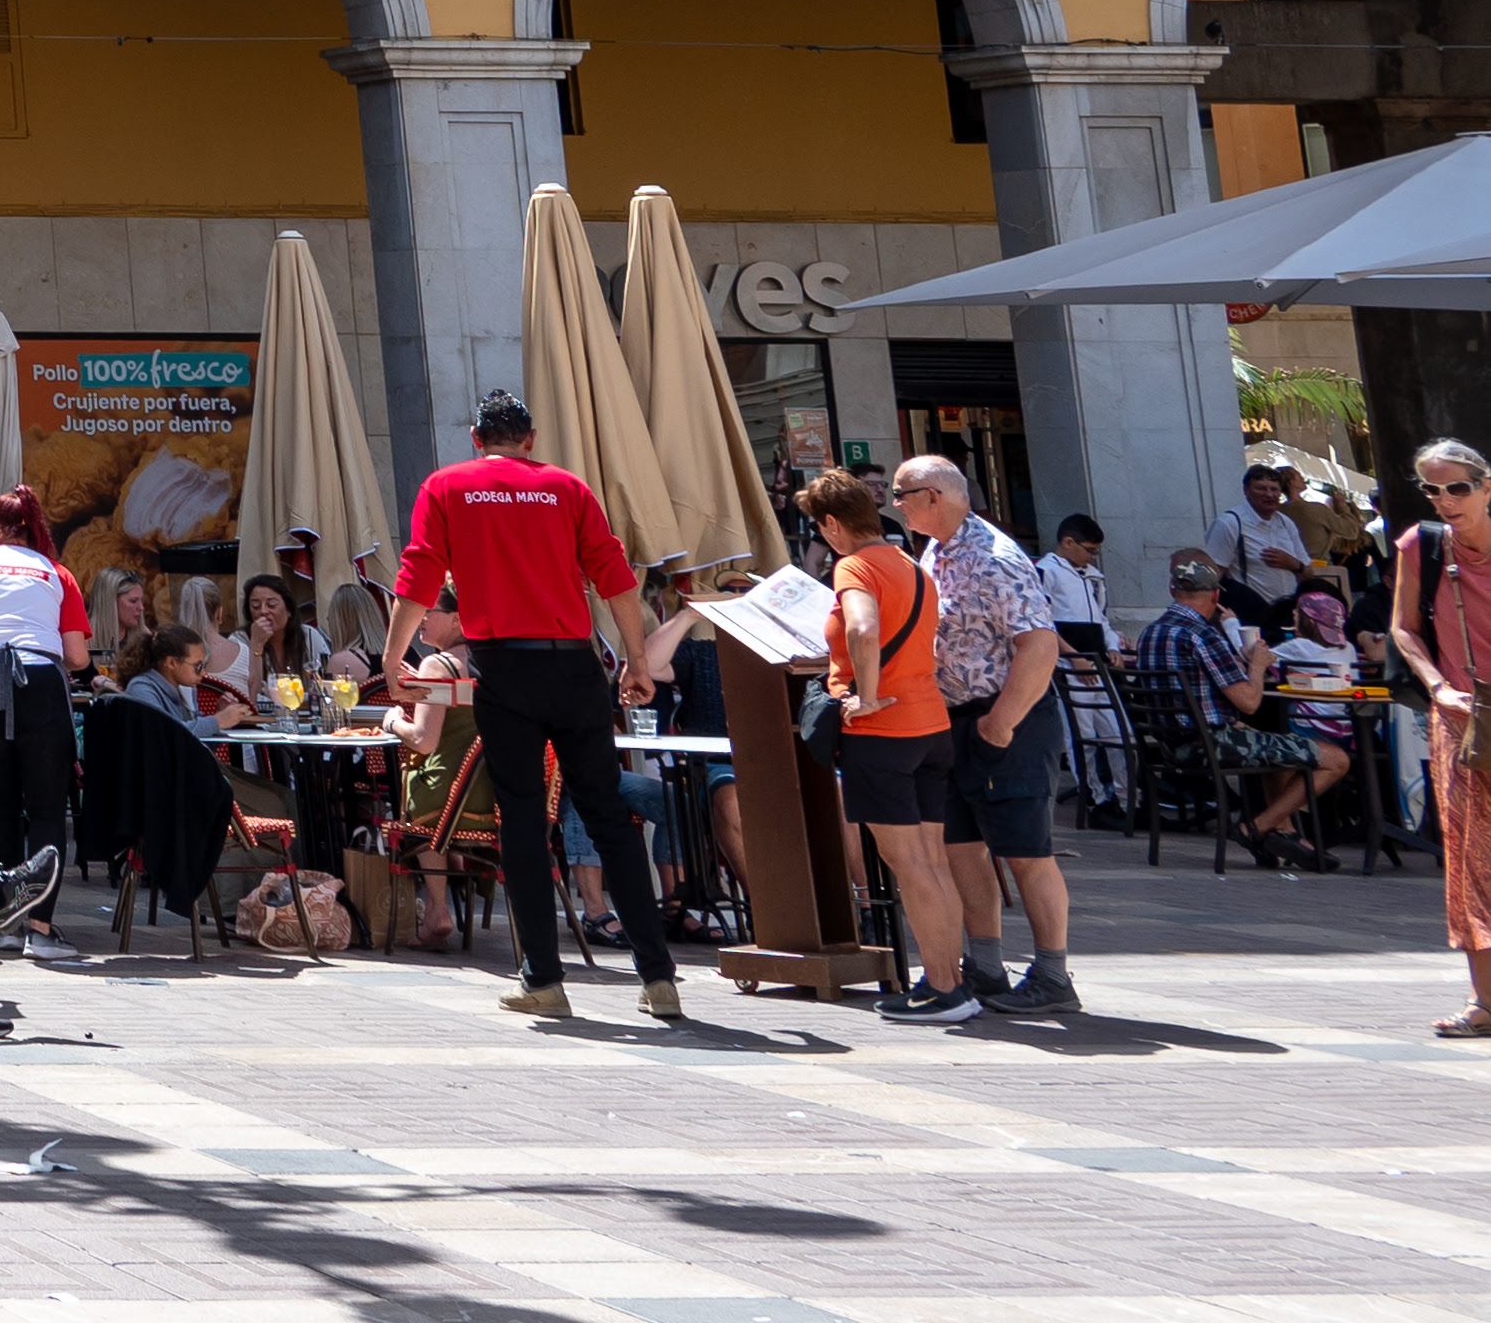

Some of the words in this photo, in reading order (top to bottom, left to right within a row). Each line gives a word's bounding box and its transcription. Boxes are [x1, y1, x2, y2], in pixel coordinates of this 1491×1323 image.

[32, 363, 79, 382] Pollo
[83, 359, 149, 382] 100%
[150, 349, 243, 390] fresco
[52, 392, 140, 413] Crujiente
[144, 397, 176, 414] por
[179, 393, 237, 414] fuera,
[60, 415, 129, 436] Jugoso
[133, 419, 165, 436] por
[168, 415, 233, 434] dentro
[852, 445, 864, 460] B
[464, 491, 513, 505] BODEGA
[515, 491, 558, 506] MAYOR
[14, 567, 45, 578] MAYOR
